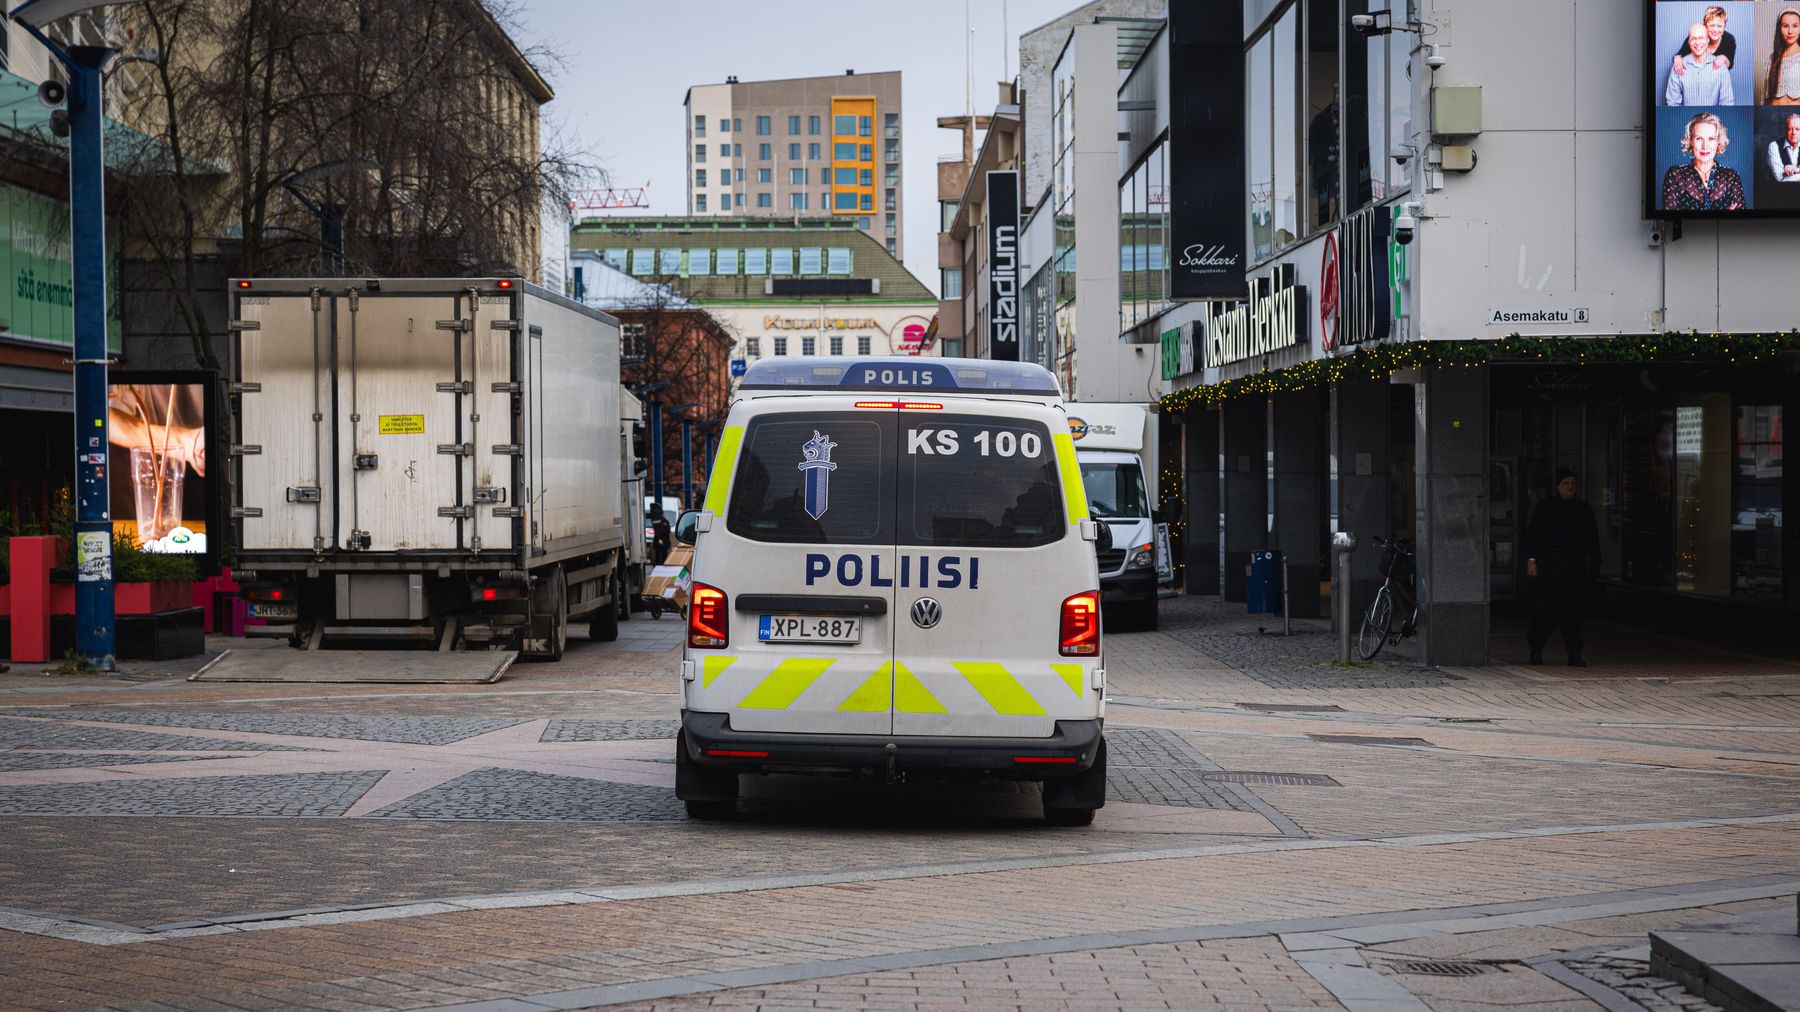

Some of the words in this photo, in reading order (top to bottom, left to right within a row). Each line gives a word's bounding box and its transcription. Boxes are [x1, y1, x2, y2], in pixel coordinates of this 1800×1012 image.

[1179, 243, 1239, 266] Sokkari
[17, 268, 35, 300] sitä
[991, 225, 1016, 342] stadium
[1493, 310, 1568, 322] Asemakatu
[1578, 310, 1585, 321] 8
[864, 369, 933, 385] POLIS
[907, 429, 960, 455] KS
[973, 430, 1042, 459] 100
[805, 553, 979, 589] POLIISI
[774, 618, 856, 638] XPL-887
